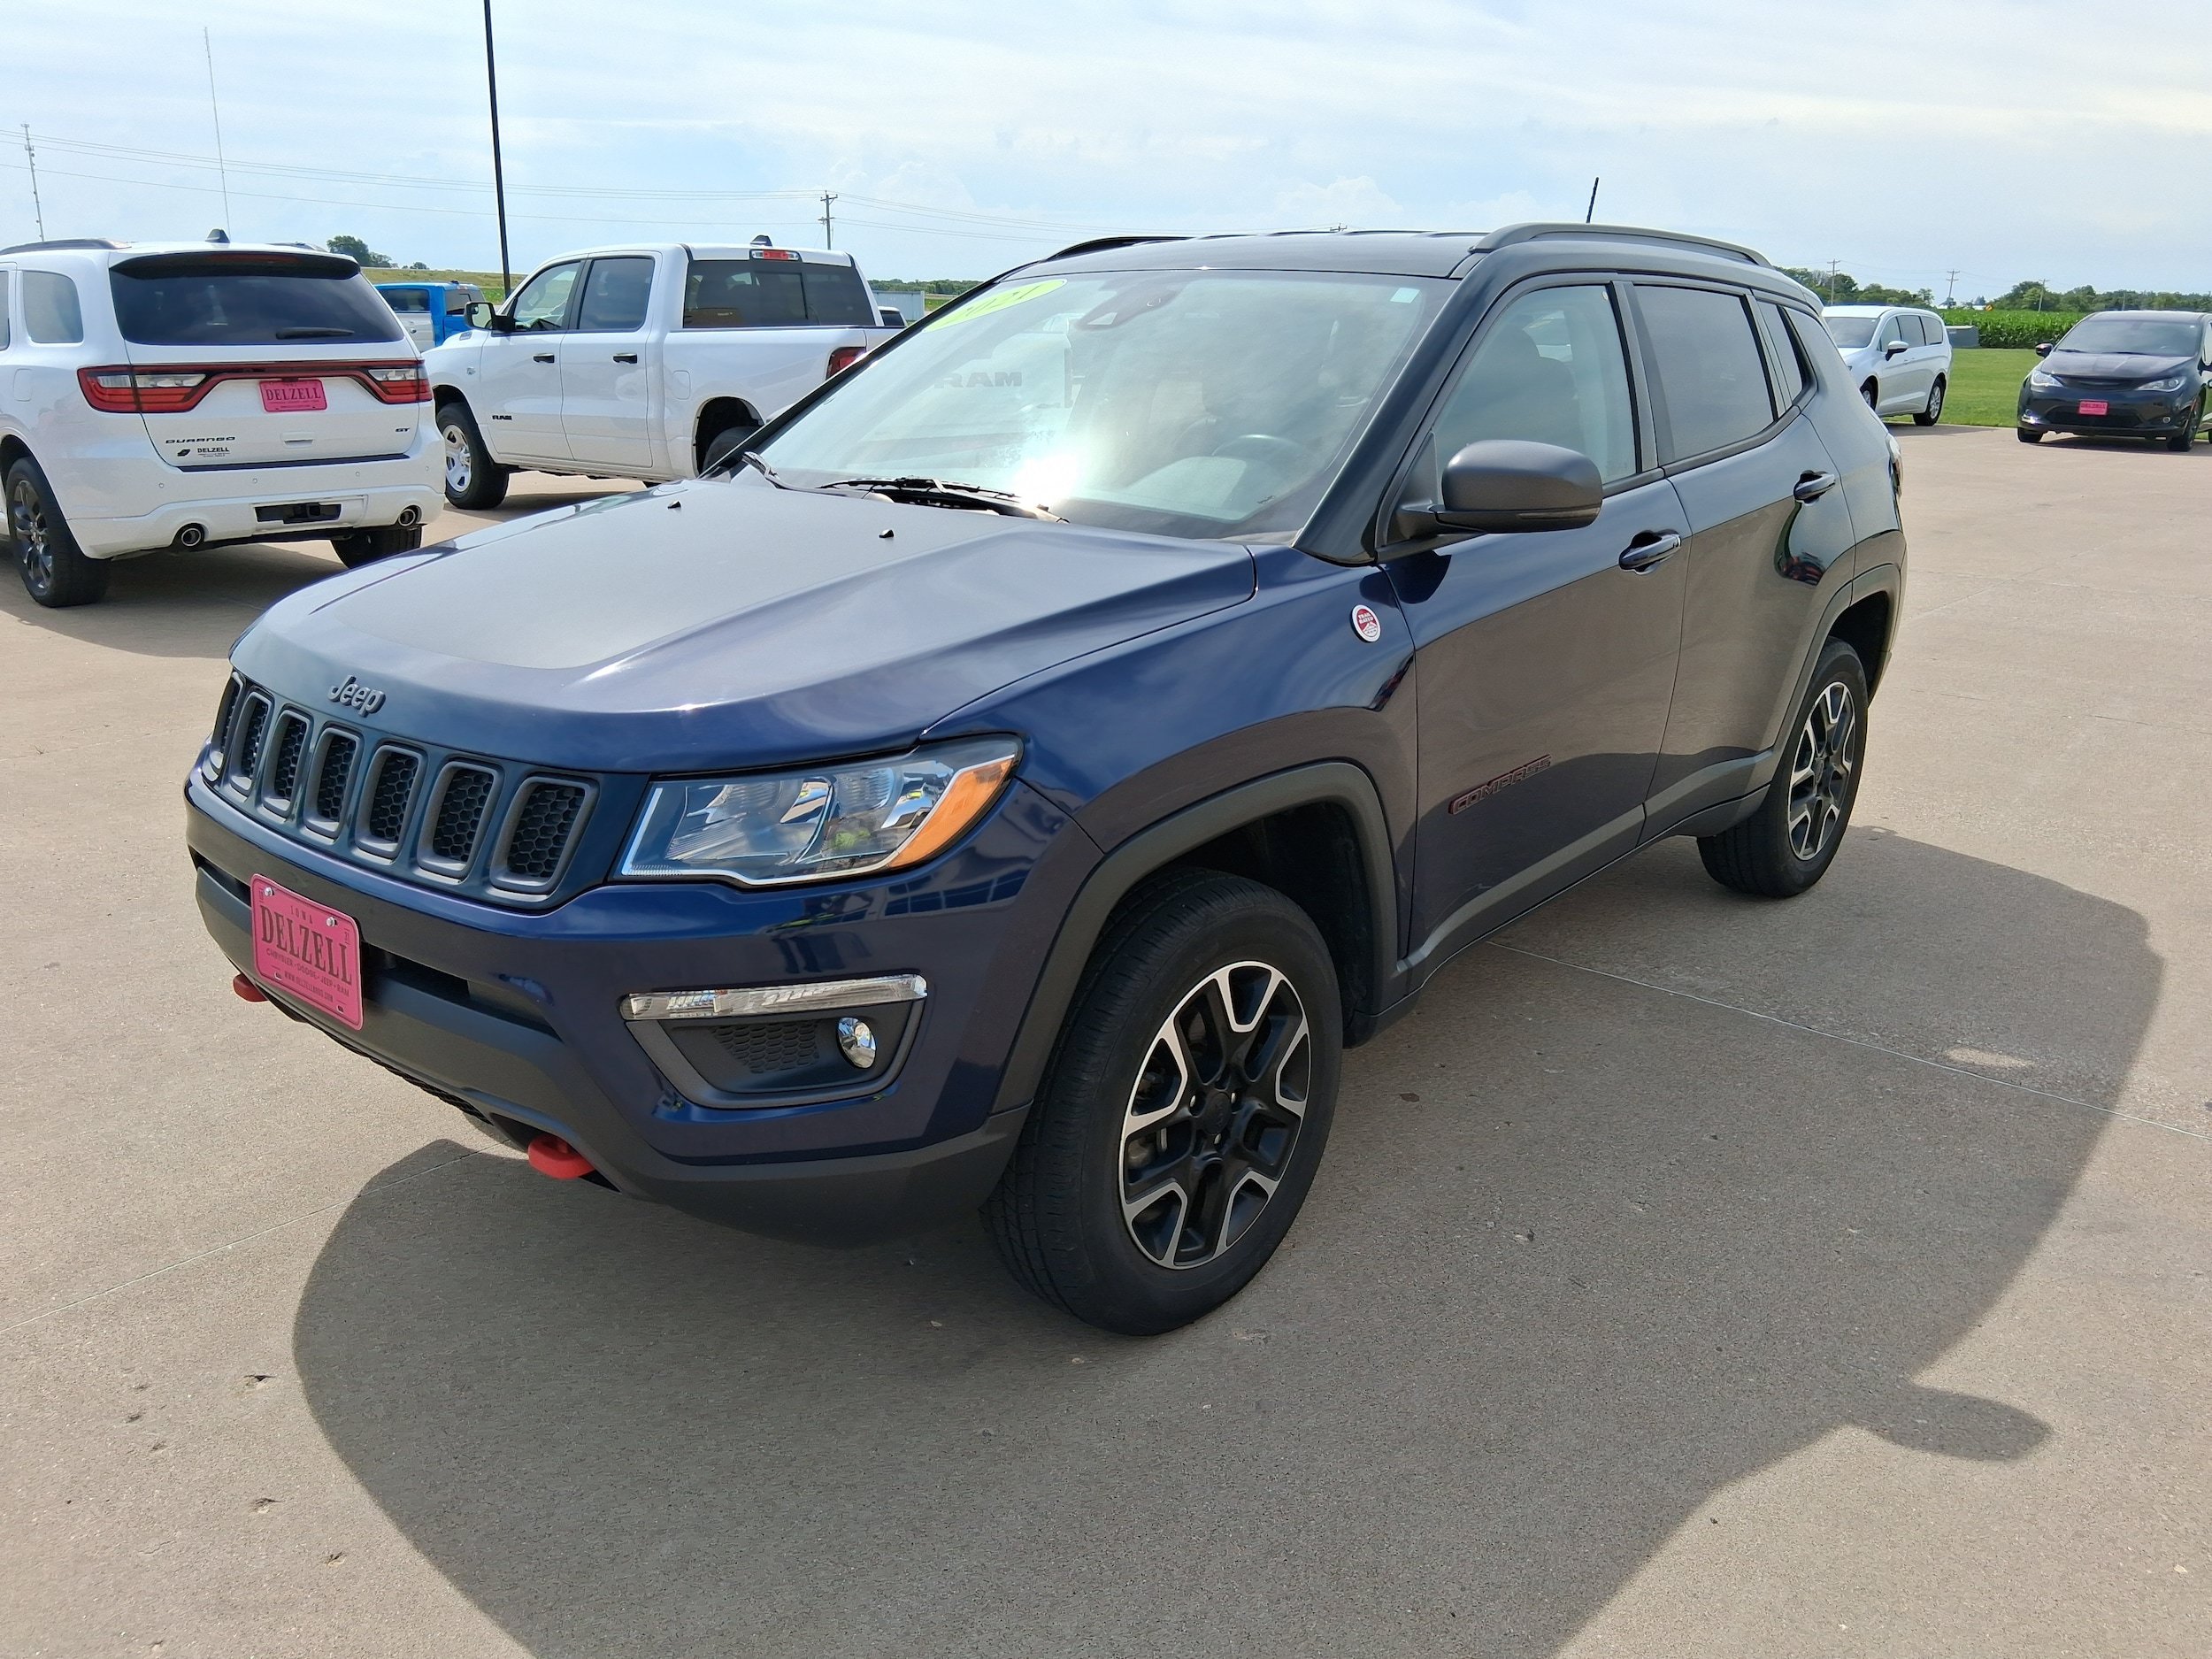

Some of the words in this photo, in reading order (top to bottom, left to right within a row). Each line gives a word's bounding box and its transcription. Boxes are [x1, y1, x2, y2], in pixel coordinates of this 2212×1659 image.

[265, 388, 321, 400] DELZELL
[933, 371, 1023, 389] RAM
[327, 674, 387, 718] Jeep
[1448, 753, 1552, 816] COMPASS
[290, 905, 313, 925] IOWA
[259, 904, 352, 987] DELZELL
[265, 948, 294, 967] CHRYSLER
[319, 975, 334, 987] JEEP
[336, 982, 349, 996] RAM
